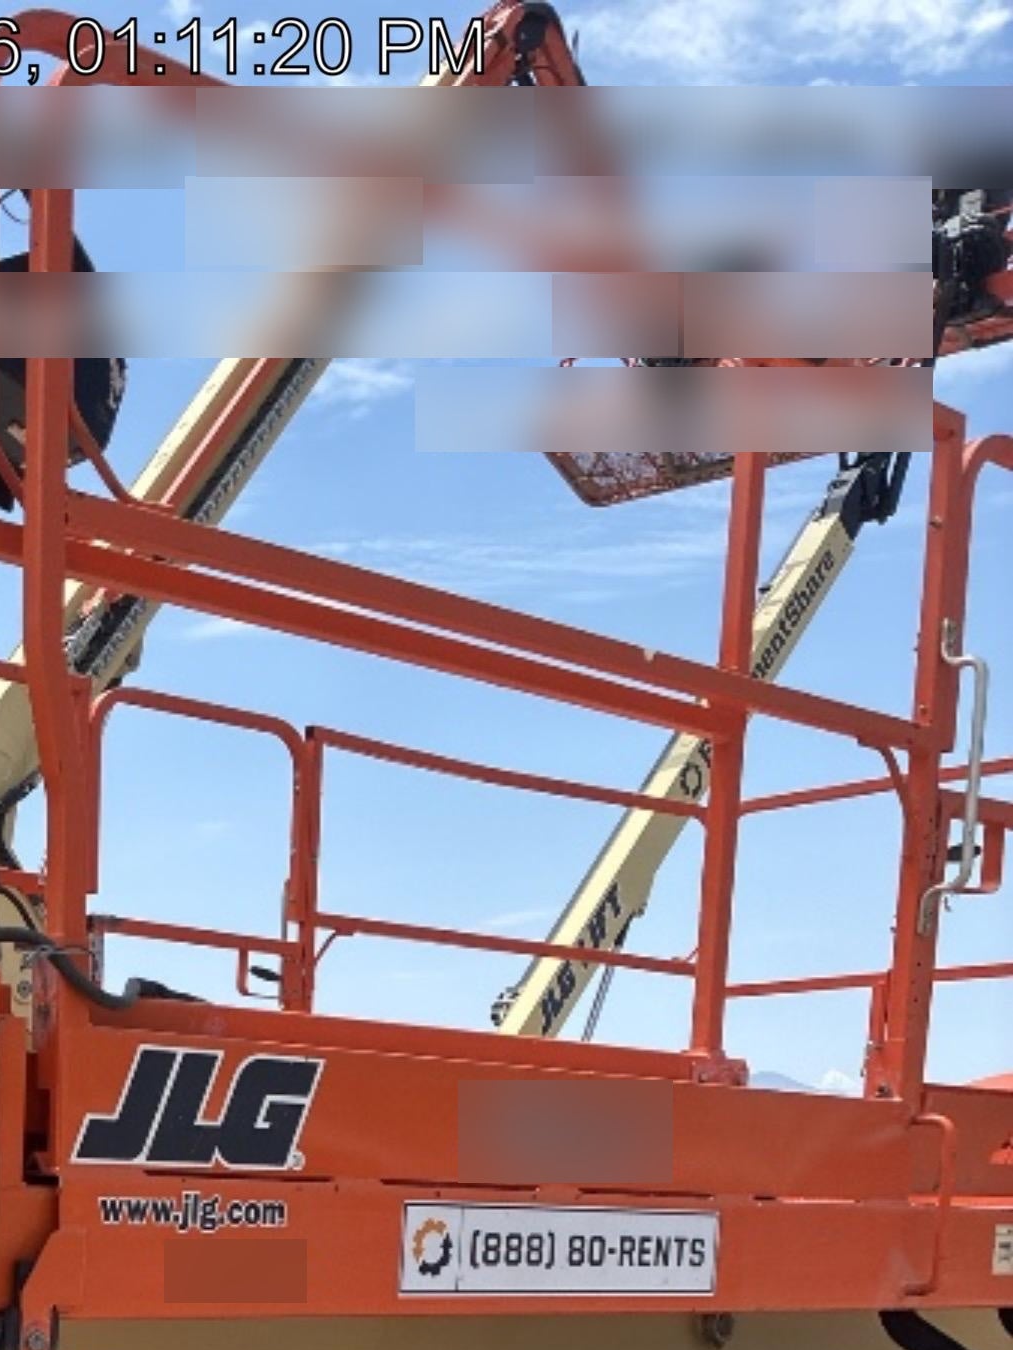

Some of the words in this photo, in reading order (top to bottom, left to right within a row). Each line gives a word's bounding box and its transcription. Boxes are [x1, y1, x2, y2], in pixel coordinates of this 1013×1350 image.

[70, 1044, 325, 1170] JLG
[98, 1191, 287, 1233] www.jlg.com
[469, 1229, 555, 1270] (888)
[567, 1234, 707, 1268] 80-RENTS
